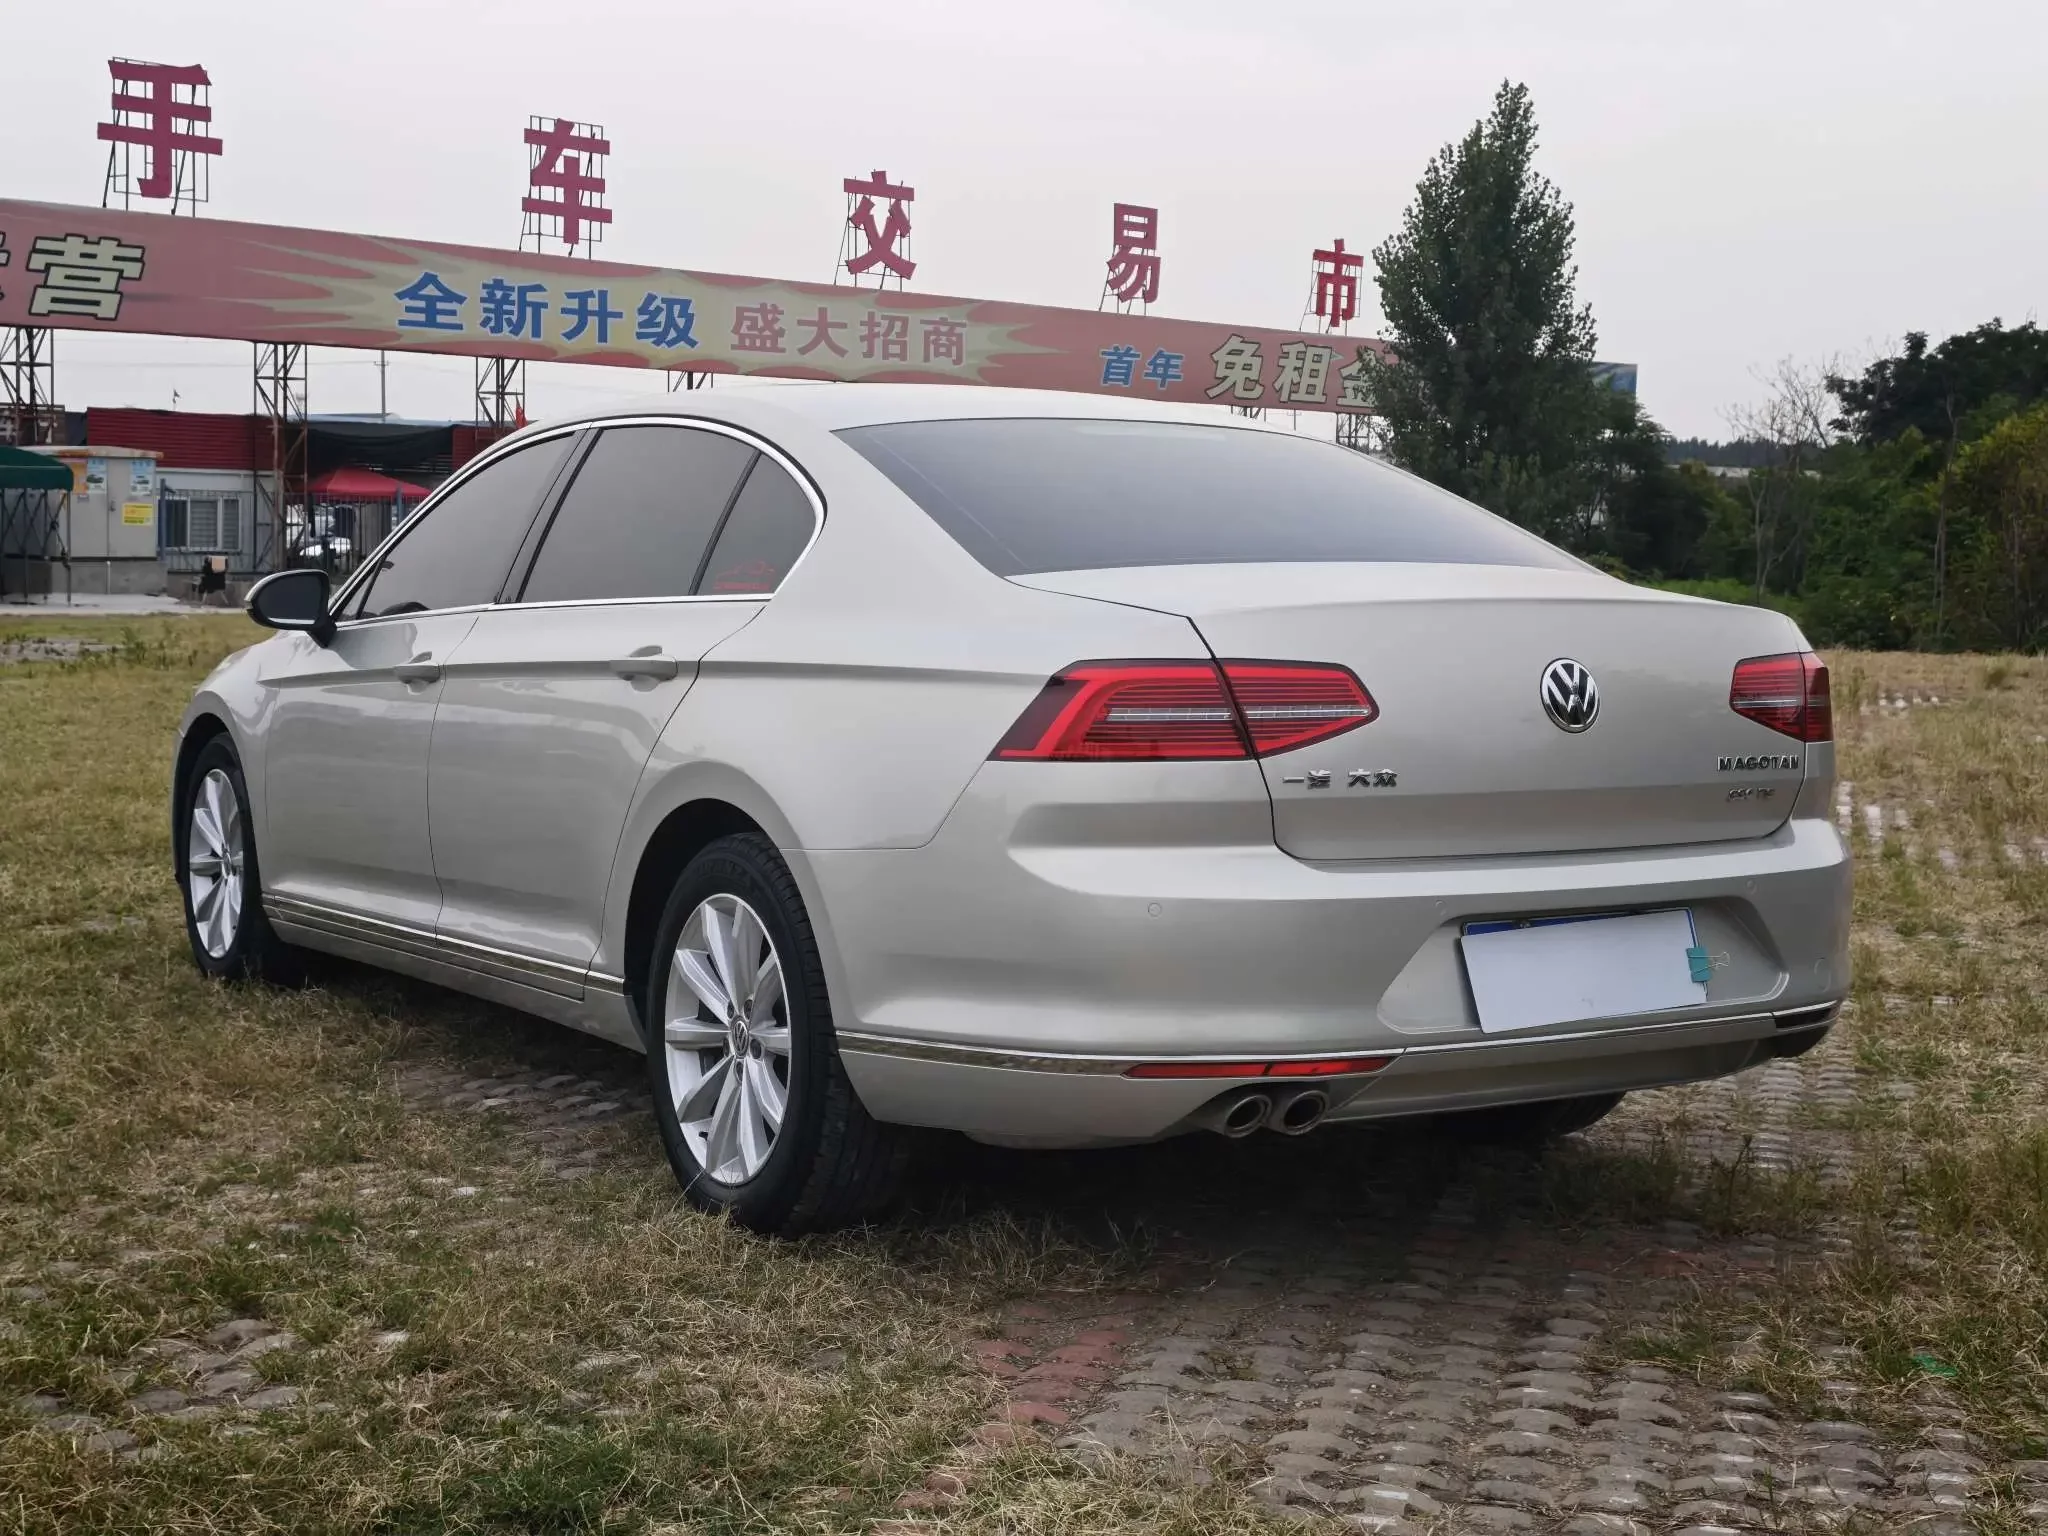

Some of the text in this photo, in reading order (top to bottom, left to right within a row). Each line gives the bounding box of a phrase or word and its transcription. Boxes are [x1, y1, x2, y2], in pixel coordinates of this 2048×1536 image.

[393, 271, 968, 367] 全新升级 盛大招商
[1099, 344, 1185, 390] 首年
[1717, 754, 1799, 771] MAGOTAN
